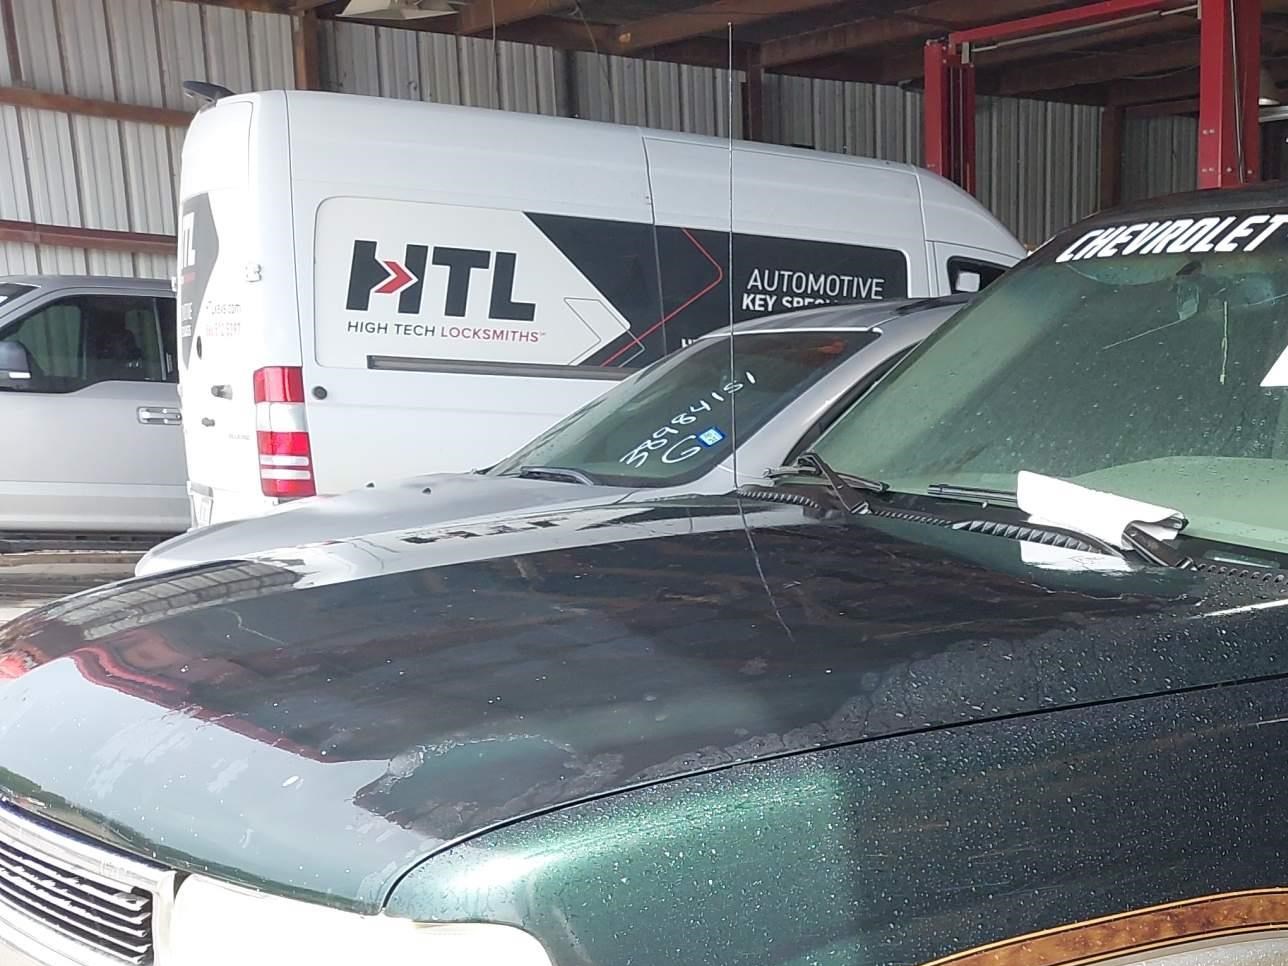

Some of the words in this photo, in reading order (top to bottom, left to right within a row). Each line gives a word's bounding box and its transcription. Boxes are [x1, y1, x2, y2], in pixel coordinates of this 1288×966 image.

[345, 239, 537, 322] HTL
[746, 268, 885, 300] AUTOMOTIVE
[741, 292, 778, 312] KEY
[347, 321, 388, 334] HIGH
[393, 323, 436, 337] TECH
[440, 326, 540, 343] LOCKSMITHS
[619, 371, 756, 468] 38984151
